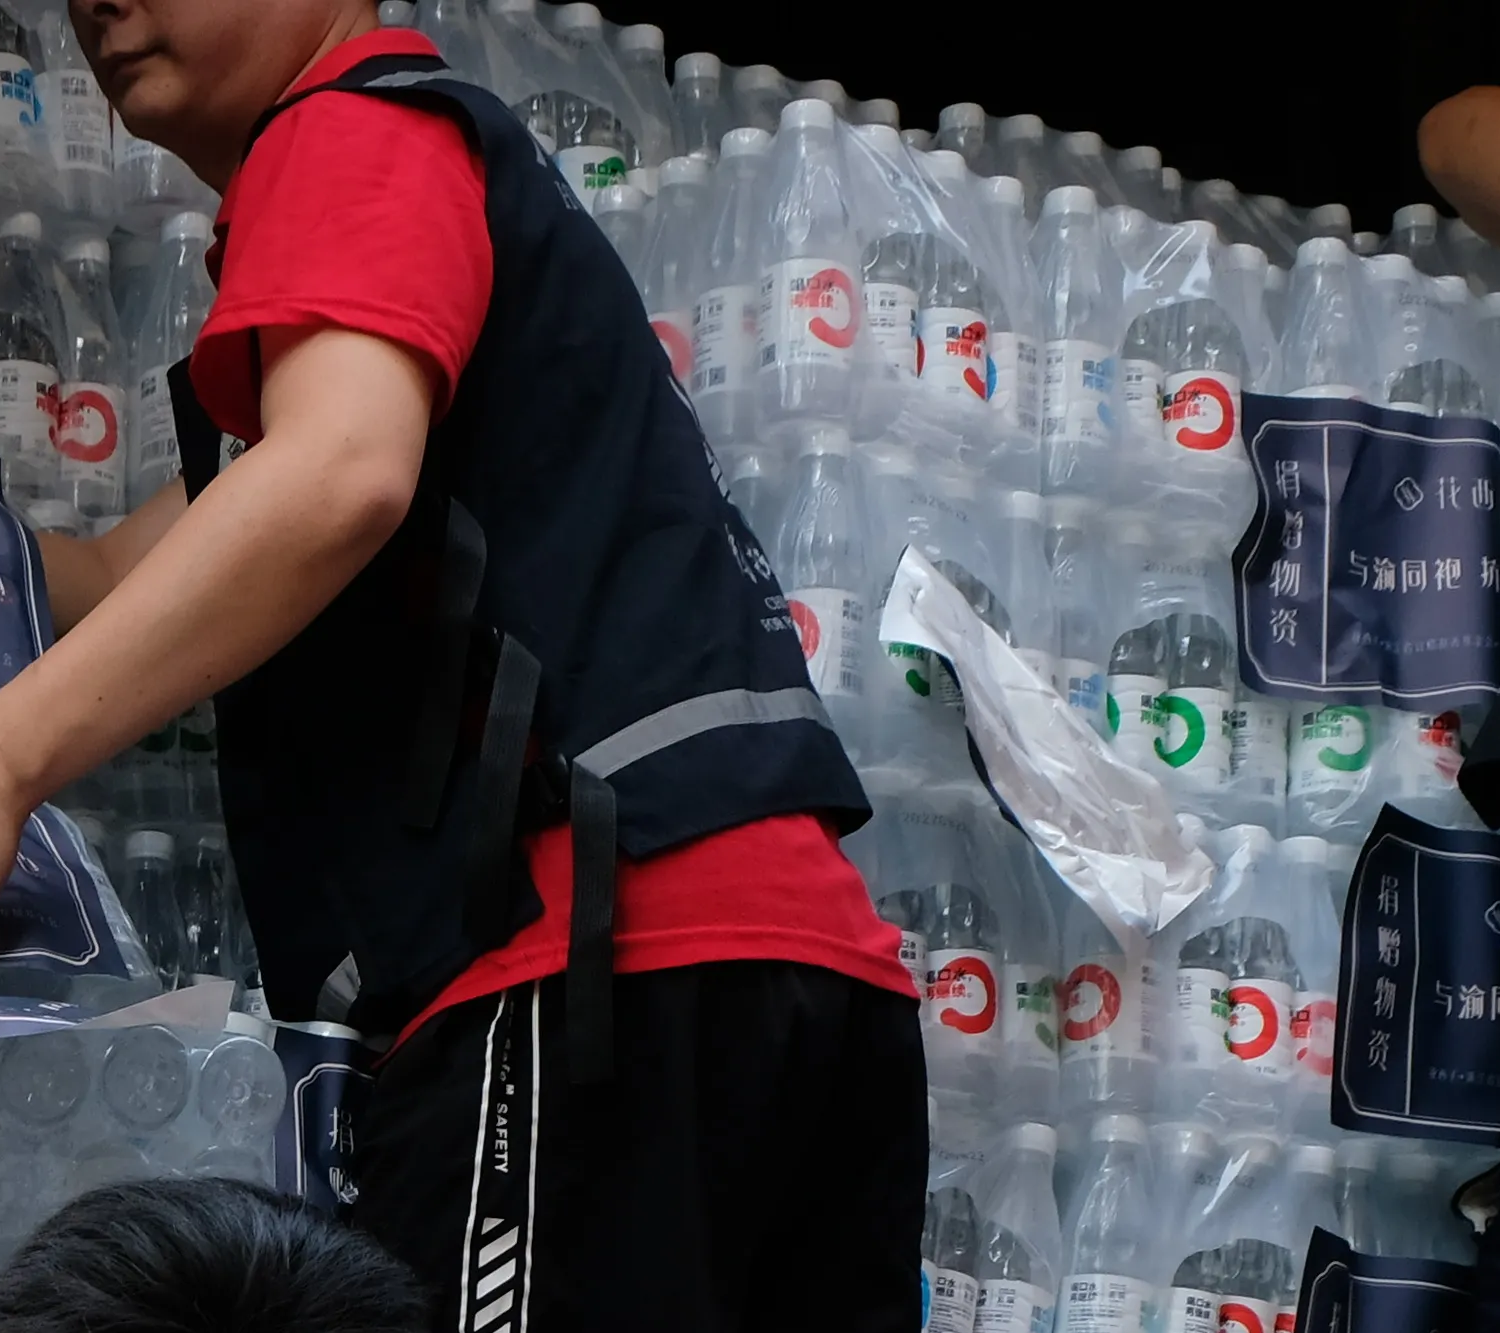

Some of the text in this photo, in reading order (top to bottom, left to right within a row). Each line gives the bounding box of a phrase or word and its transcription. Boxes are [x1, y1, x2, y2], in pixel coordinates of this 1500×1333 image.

[1347, 550, 1462, 593] 与渝同袍
[494, 1102, 508, 1174] SAFETY
